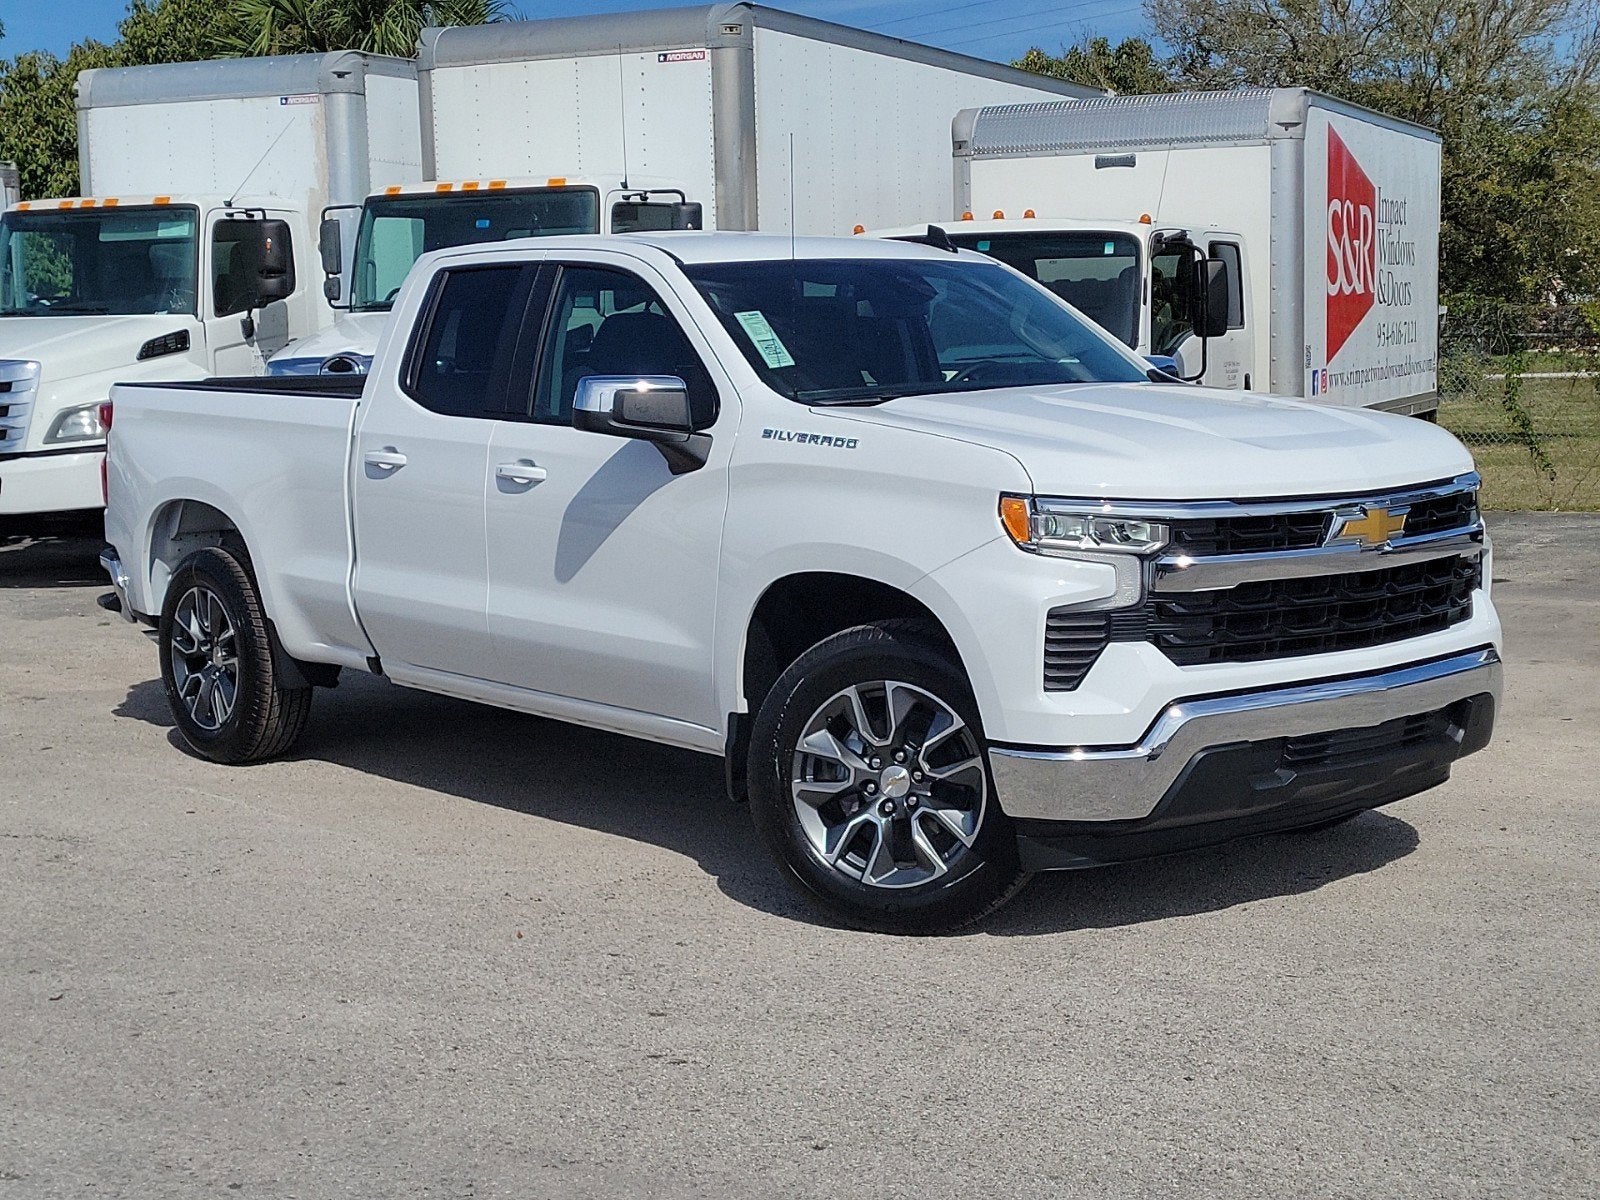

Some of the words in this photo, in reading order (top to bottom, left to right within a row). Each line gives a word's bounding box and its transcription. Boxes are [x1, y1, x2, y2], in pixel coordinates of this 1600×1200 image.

[666, 51, 705, 61] MORGAN
[1378, 186, 1407, 236] Impact
[1326, 198, 1376, 297] S&R
[1378, 228, 1416, 267] Windows
[1376, 320, 1418, 347] 954-616-7121
[762, 428, 859, 449] SILVERADO
